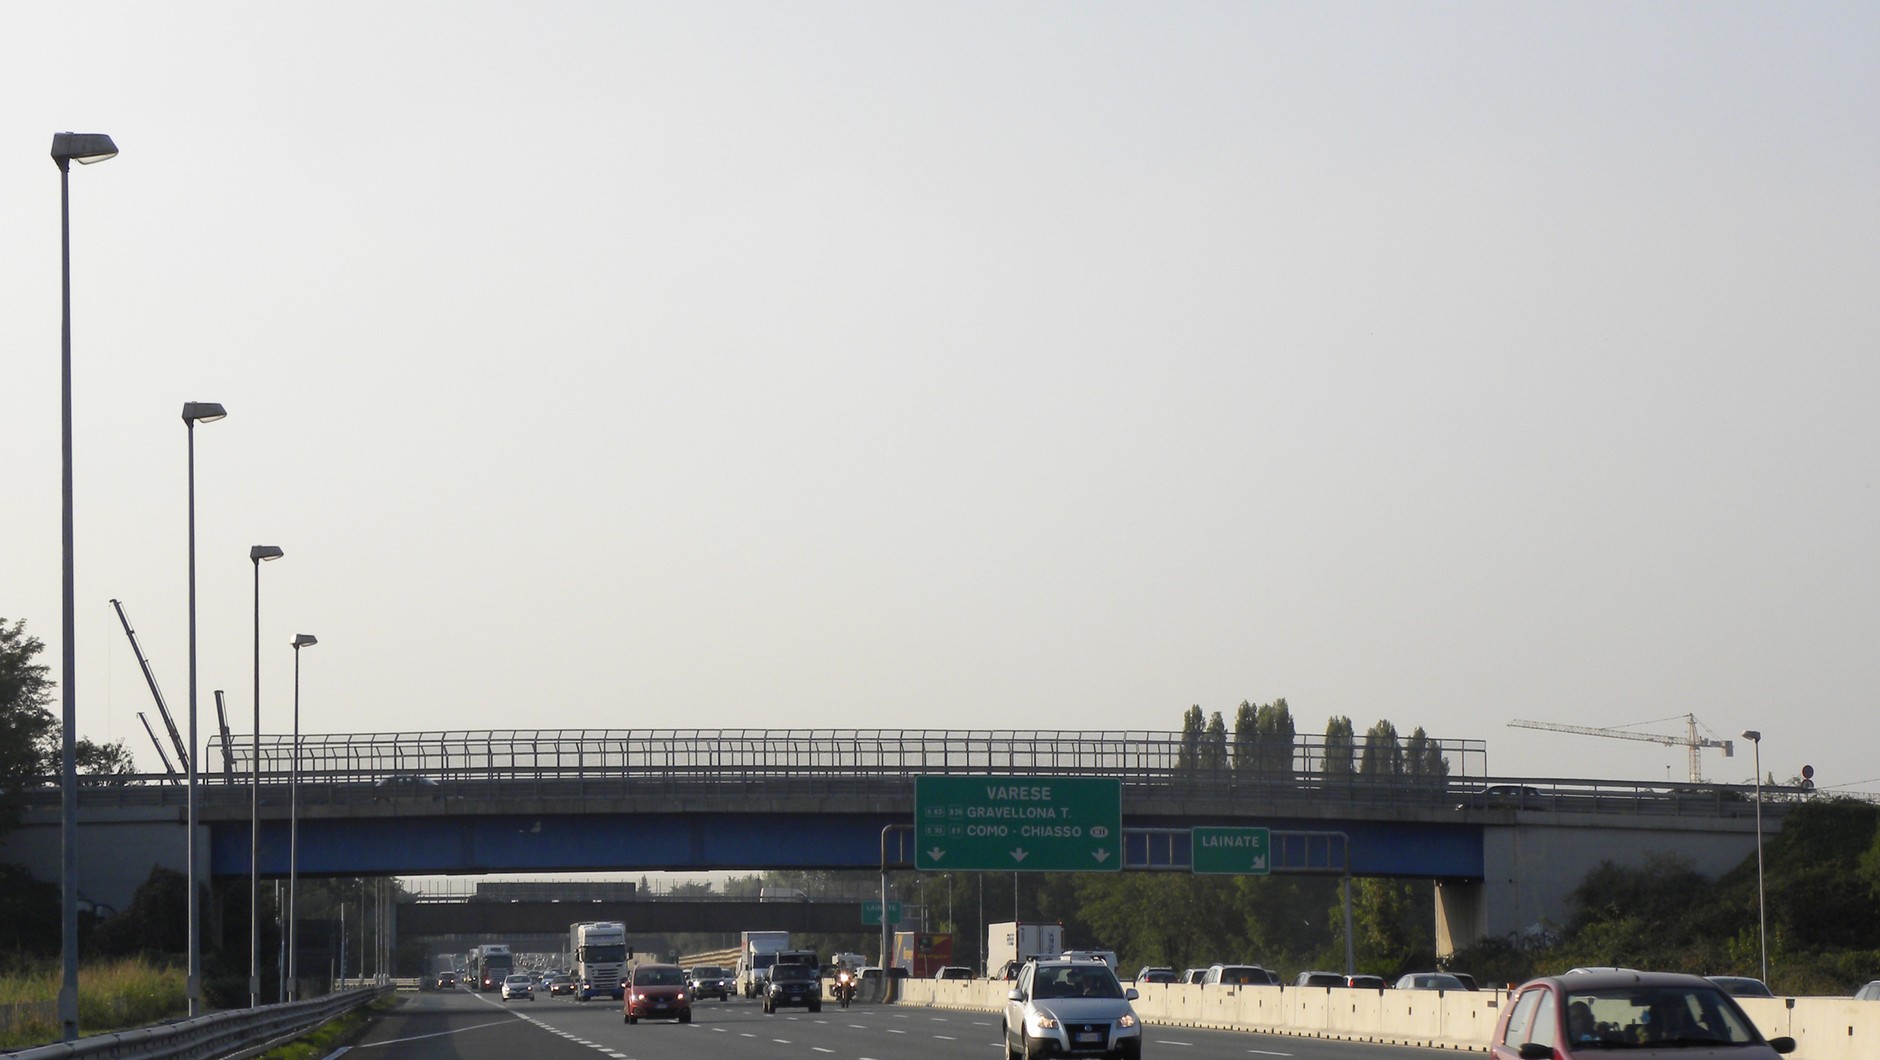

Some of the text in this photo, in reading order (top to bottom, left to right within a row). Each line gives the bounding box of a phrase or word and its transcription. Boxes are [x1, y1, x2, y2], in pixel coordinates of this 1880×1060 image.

[986, 787, 1052, 800] VARESE
[967, 807, 1056, 818] GRAVELLONA
[1060, 808, 1072, 819] T.
[967, 826, 1008, 837] COMO
[1021, 826, 1082, 837] CHIASSO
[1202, 835, 1260, 848] LAINATE
